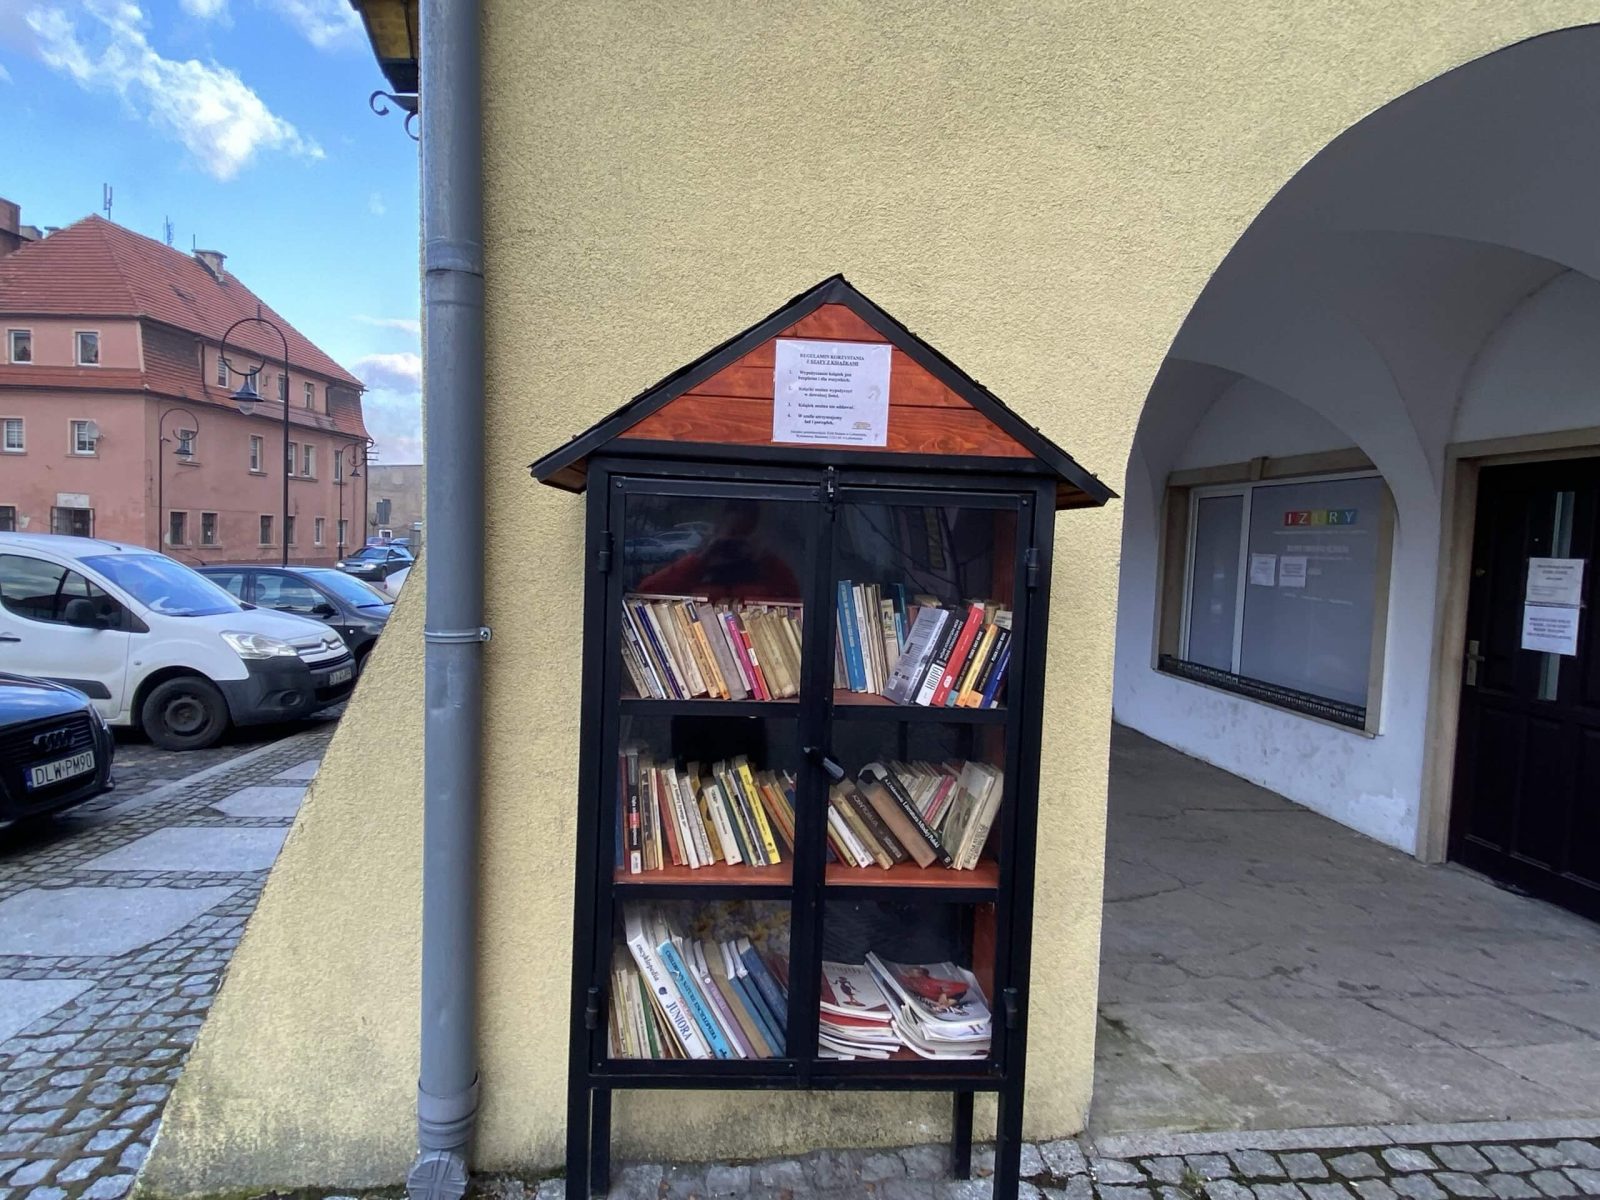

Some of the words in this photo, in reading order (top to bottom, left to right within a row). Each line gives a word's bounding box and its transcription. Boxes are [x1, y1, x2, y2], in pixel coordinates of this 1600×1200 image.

[35, 762, 62, 785] DLW
[65, 753, 93, 776] PM90
[636, 944, 660, 982] encyklopedia
[666, 1001, 693, 1041] JUNIORA
